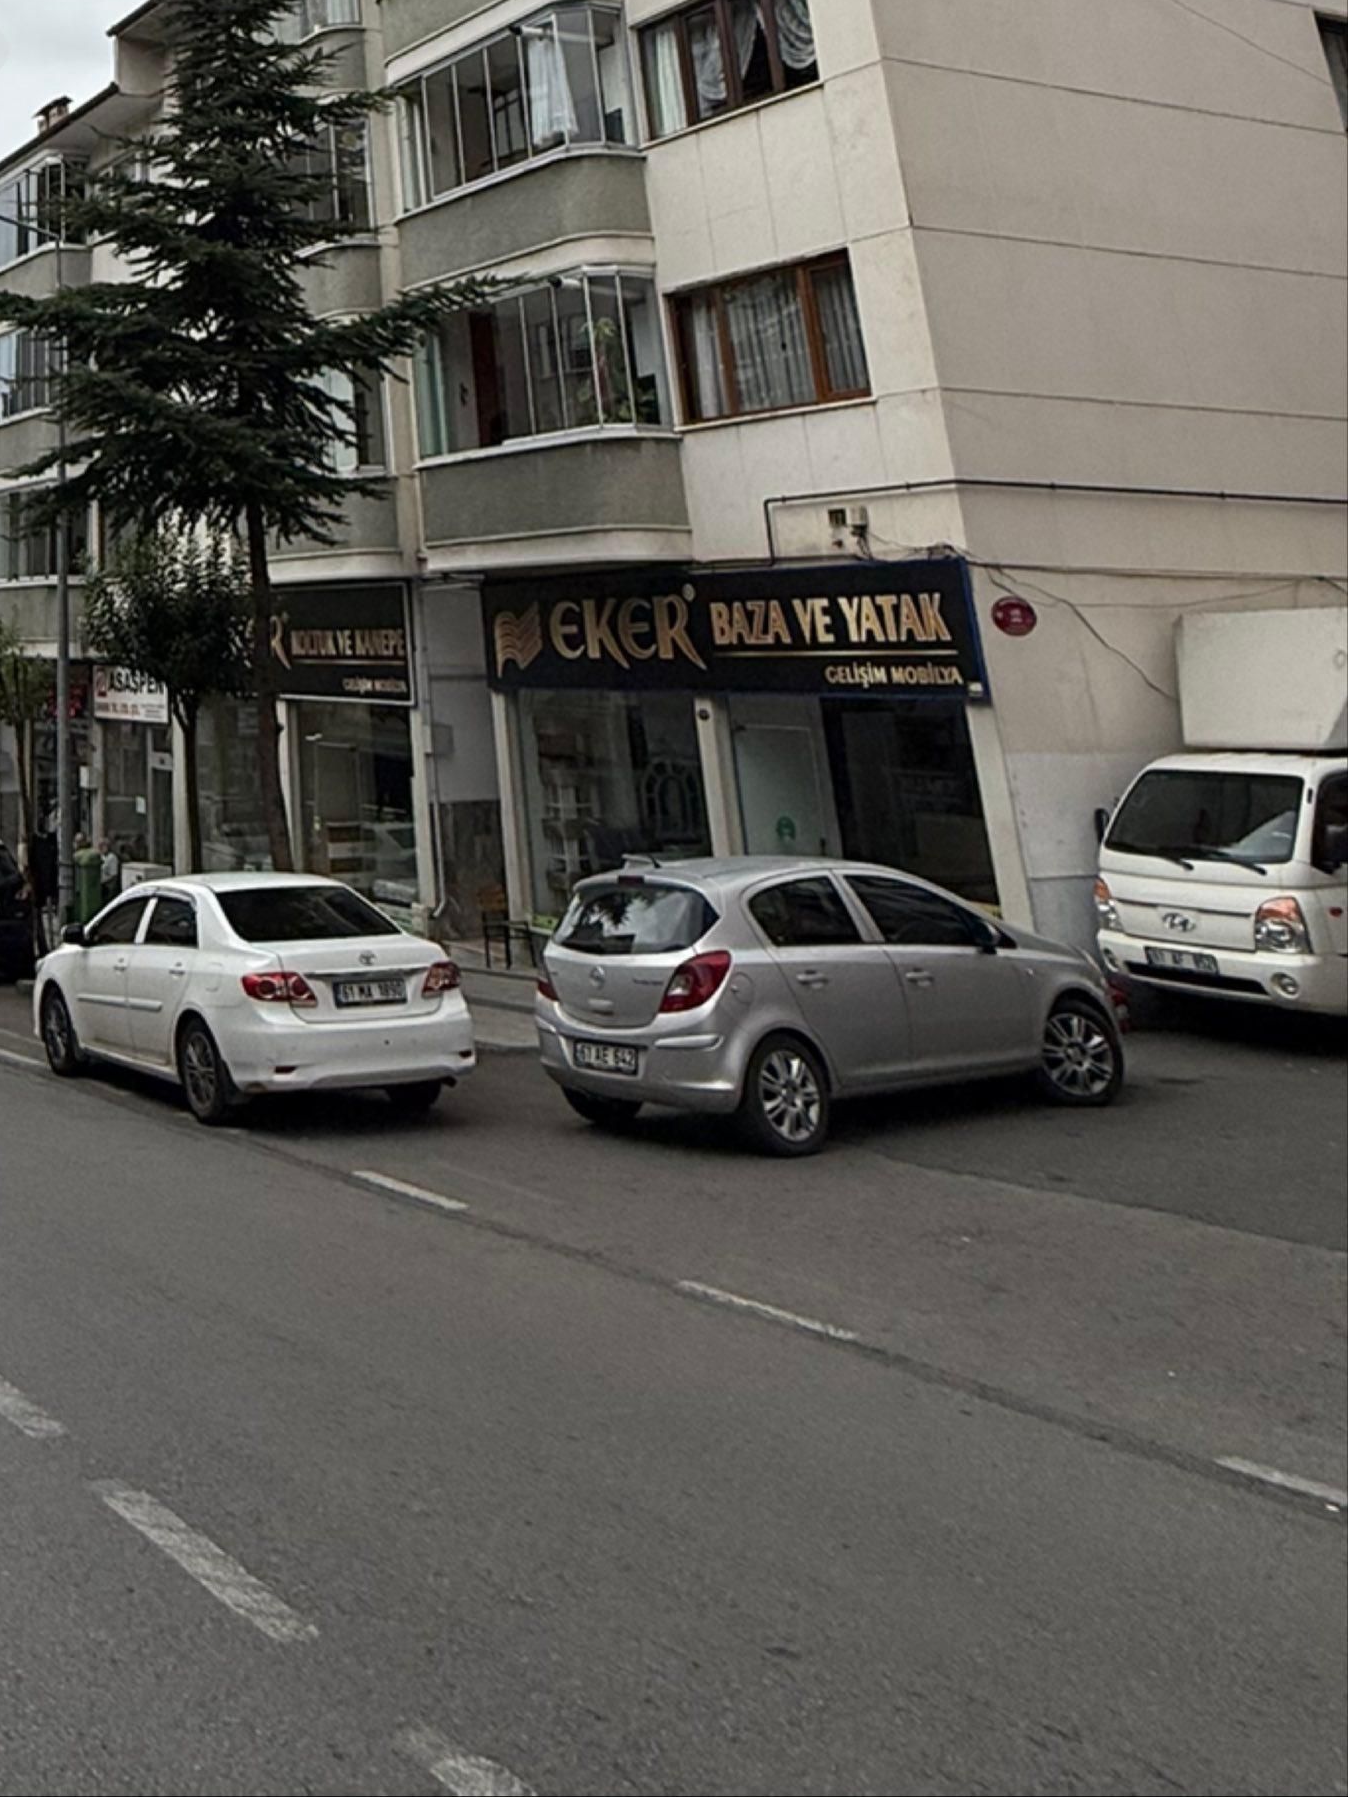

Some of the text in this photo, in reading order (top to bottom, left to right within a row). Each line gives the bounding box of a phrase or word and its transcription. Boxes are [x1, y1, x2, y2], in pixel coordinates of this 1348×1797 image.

[550, 594, 707, 670] EKER
[709, 593, 952, 645] BAZA VE YATAK
